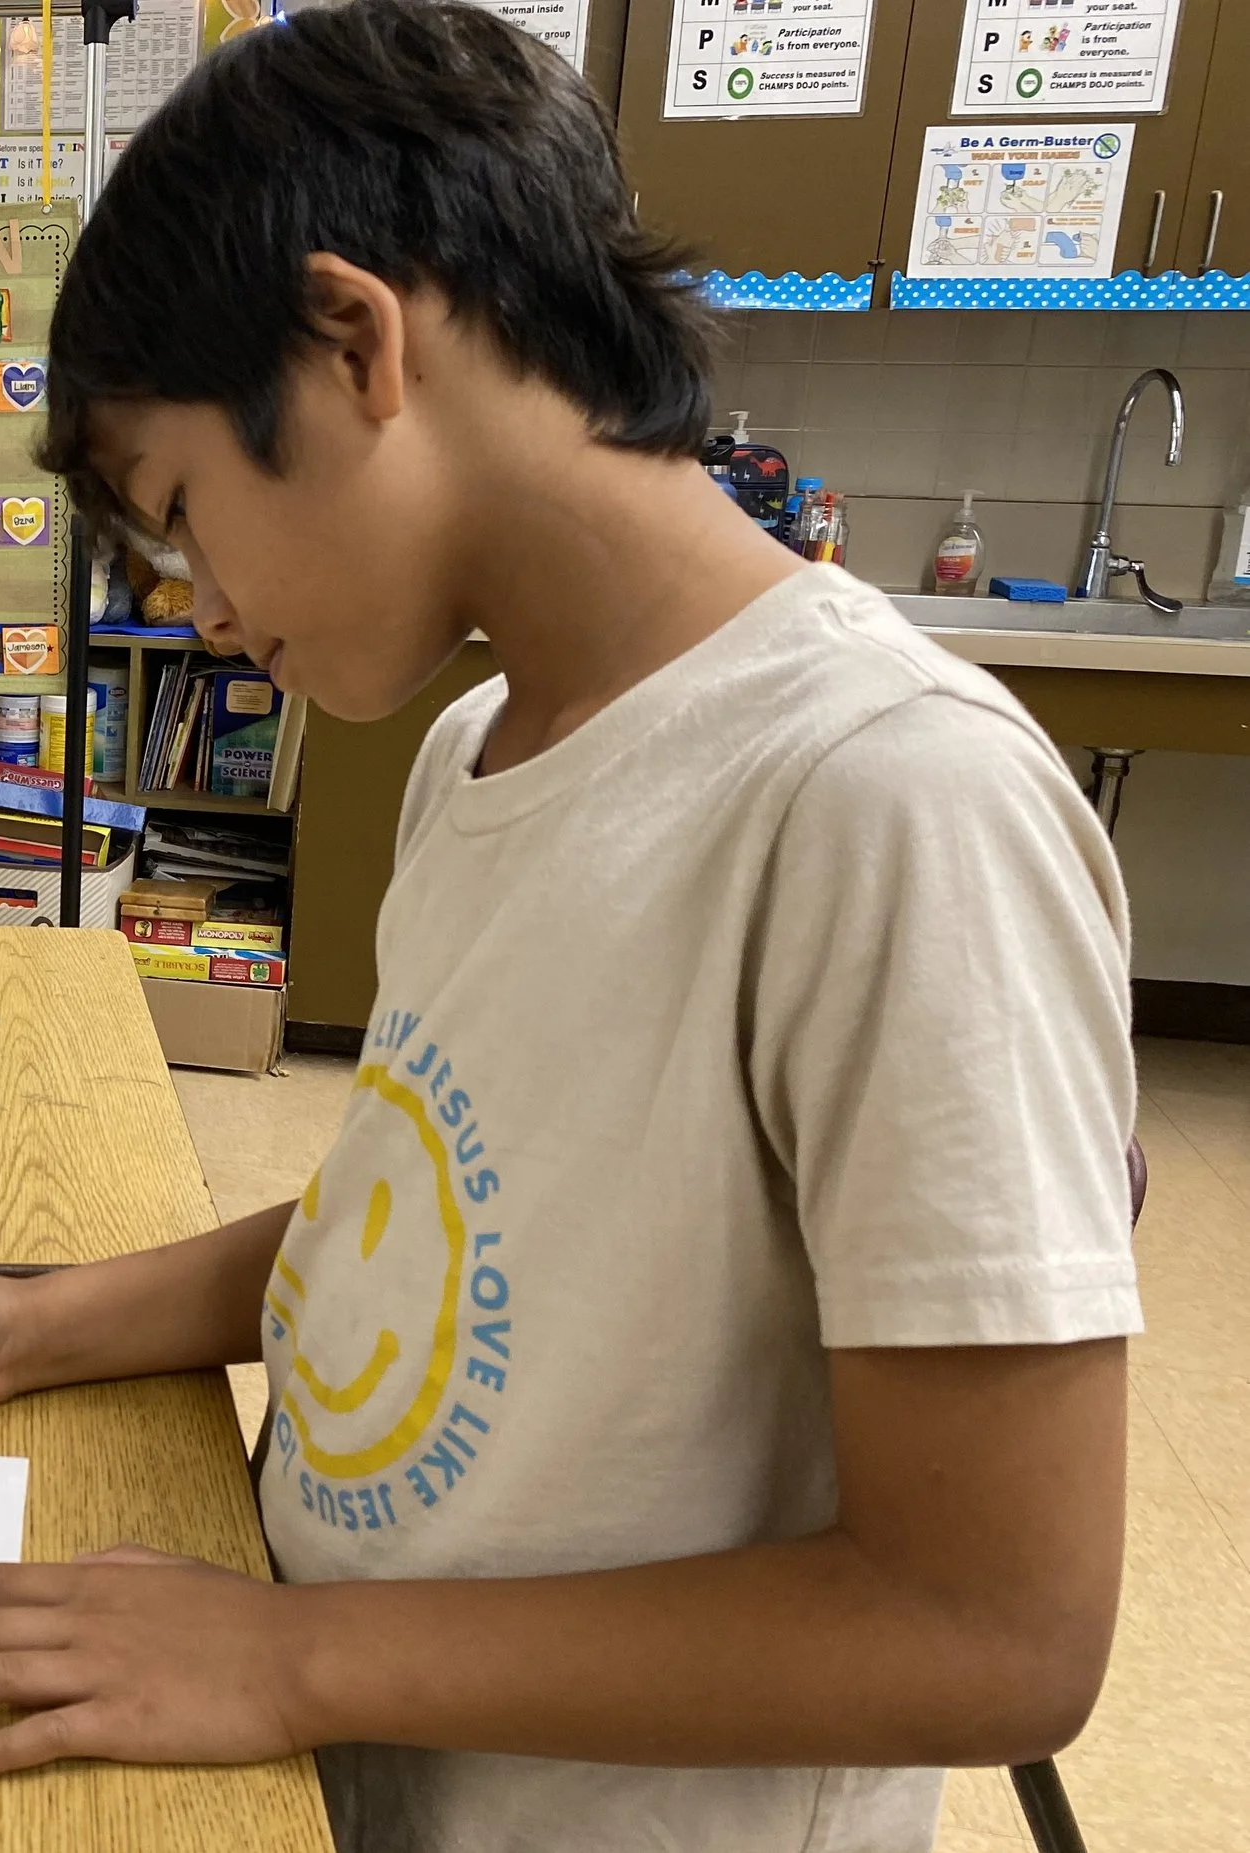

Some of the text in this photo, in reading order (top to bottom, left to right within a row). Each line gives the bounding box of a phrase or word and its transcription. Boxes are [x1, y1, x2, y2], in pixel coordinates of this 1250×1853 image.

[501, 4, 564, 15] Normal inside
[792, 3, 833, 13] your seat.
[1086, 2, 1137, 13] your seat.
[778, 27, 841, 37] Participation
[1084, 22, 1151, 32] Participation
[544, 30, 570, 41] group
[699, 29, 714, 50] P
[1081, 35, 1117, 43] is from
[776, 40, 860, 51] is from everyone.
[984, 32, 1000, 51] P
[1079, 48, 1130, 57] everyone.
[760, 69, 856, 80] Success is measured in
[1099, 69, 1142, 78] measured
[1144, 68, 1152, 76] in
[692, 70, 707, 90] S
[759, 80, 849, 90] CHAMPS DOJO points.
[977, 74, 993, 93] S
[1050, 80, 1145, 90] CHAMPS DOJO points.
[961, 136, 1094, 147] Be A Germ-Buster
[29, 146, 44, 154] spea
[58, 143, 86, 152] THIN
[0, 158, 9, 169] T
[18, 158, 63, 169] Is it Te?
[17, 177, 25, 187] Is
[27, 177, 33, 187] it
[7, 643, 46, 652] Jameson
[223, 750, 273, 761] POWER
[222, 766, 272, 779] SCIENCE
[198, 930, 244, 940] MONOPOLY
[154, 960, 206, 972] SCRABBLE
[406, 1043, 500, 1204] JESUS
[466, 1231, 512, 1393] LOVE
[405, 1402, 491, 1508] LIKE
[300, 1472, 398, 1531] JESUS
